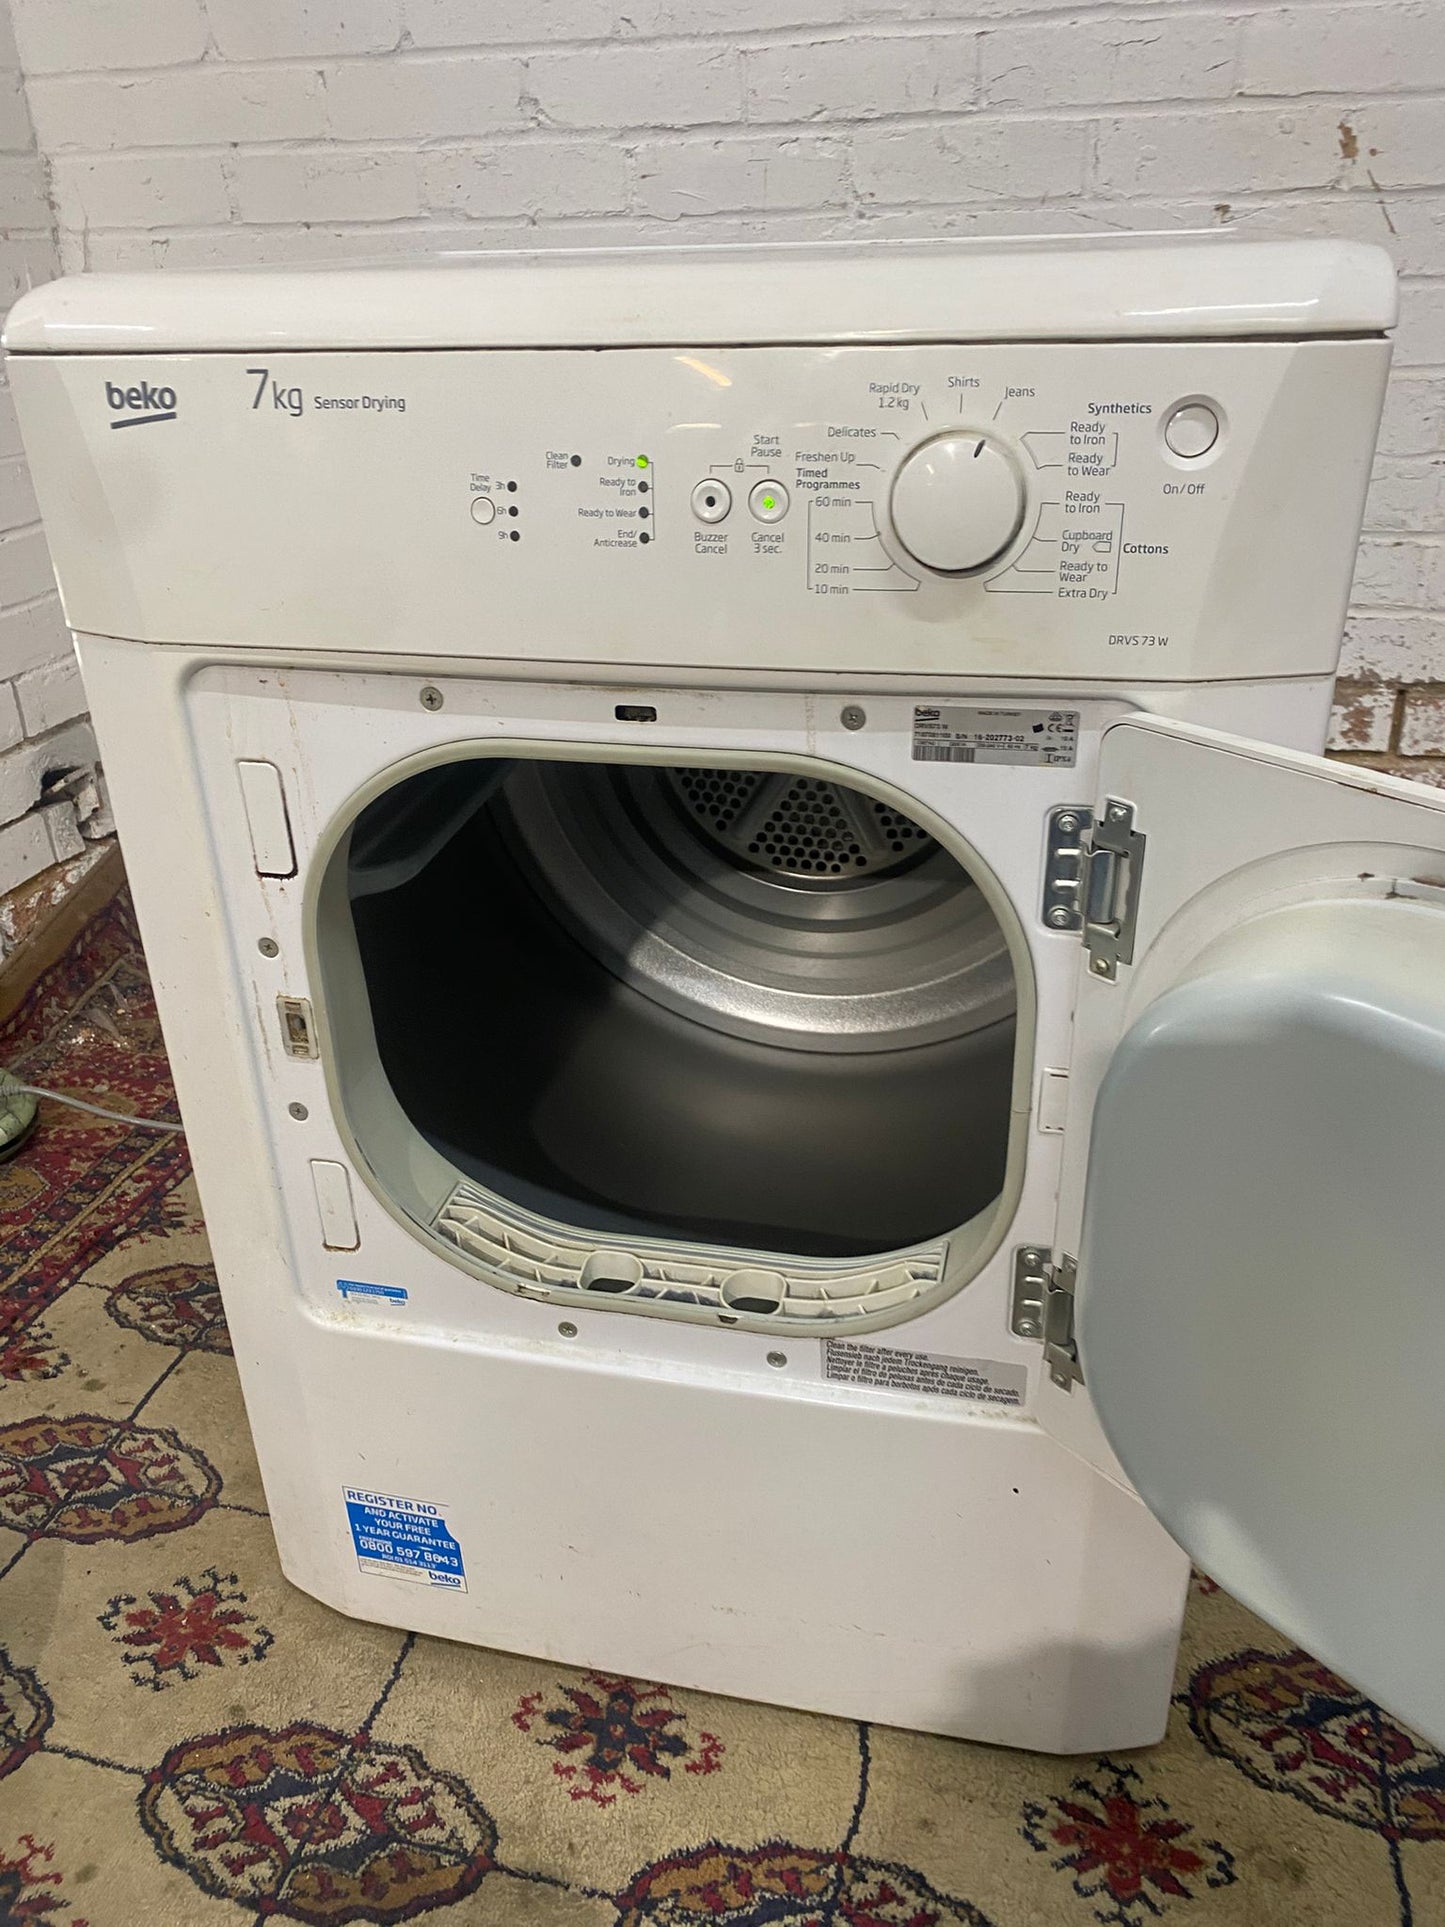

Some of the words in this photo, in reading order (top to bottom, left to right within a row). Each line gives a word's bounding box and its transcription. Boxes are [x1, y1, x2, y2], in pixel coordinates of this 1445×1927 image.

[948, 377, 980, 388] Shirts
[869, 383, 899, 395] Rapid
[902, 383, 920, 396] Dry
[1004, 387, 1035, 399] Jeans
[105, 381, 176, 410] beko
[314, 396, 359, 409] Sensor
[362, 396, 405, 412] Drying
[897, 398, 909, 410] kg
[1088, 402, 1152, 416] Synthetics
[828, 427, 876, 438] Delicates
[1070, 422, 1105, 434] Ready
[754, 435, 779, 445] Start
[1070, 437, 1081, 445] to
[1084, 436, 1105, 445] Iron
[546, 451, 568, 460] Clean
[751, 448, 782, 457] Pause
[795, 452, 838, 462] Freshen
[840, 452, 855, 463] Up
[608, 457, 635, 467] Drying
[1069, 453, 1103, 465] Ready
[547, 461, 568, 469] Filter
[797, 468, 827, 478] Timed
[1068, 467, 1079, 475] to
[1082, 467, 1110, 476] Wear
[471, 474, 490, 482] Time
[600, 478, 626, 488] Ready
[628, 479, 636, 487] to
[470, 483, 491, 493] Delay
[496, 482, 505, 490] 3h
[796, 480, 860, 490] Programmes
[620, 488, 636, 496] Iron
[1066, 491, 1100, 503] Ready
[815, 497, 830, 506] 60
[832, 497, 851, 506] min
[497, 507, 506, 515] 6h
[578, 509, 603, 518] Ready
[606, 509, 614, 517] to
[615, 509, 636, 517] Wear
[1065, 504, 1076, 513] to
[1079, 504, 1100, 513] Iron
[618, 530, 636, 539] End/
[694, 532, 728, 542] Buzzer
[751, 532, 784, 542] Cancel
[815, 533, 830, 542] 40
[832, 533, 850, 542] min
[1062, 530, 1112, 541] Cupboard
[594, 539, 637, 548] Anticrease
[1062, 542, 1080, 554] Dry
[1123, 543, 1169, 554] Cottons
[695, 544, 727, 554] Cancel
[754, 544, 760, 554] 3
[761, 545, 782, 554] sec.
[815, 564, 828, 573] 20
[830, 564, 849, 573] min
[1060, 561, 1094, 573] Ready
[1097, 562, 1108, 571] to
[1059, 573, 1087, 582] Wear
[815, 584, 828, 594] 10
[830, 584, 848, 594] min
[1058, 588, 1086, 598] Extra
[1089, 588, 1108, 600] Dry
[1109, 635, 1139, 645] DRVS
[1141, 636, 1155, 646] 73
[1158, 637, 1168, 646] W
[826, 1340, 845, 1350] Clean
[846, 1343, 858, 1351] the
[859, 1344, 876, 1353] filter
[877, 1347, 893, 1355] after
[894, 1351, 913, 1360] every
[347, 1490, 413, 1511] REGISTER
[365, 1507, 386, 1517] AND
[388, 1510, 438, 1528] ACTIVATE
[375, 1518, 402, 1530] YOUR
[405, 1524, 431, 1536] FREE
[363, 1525, 390, 1537] YEAR
[392, 1531, 455, 1550] GUARANTEE
[360, 1540, 393, 1554] 0800
[397, 1547, 420, 1558] 597
[429, 1571, 460, 1584] beko
